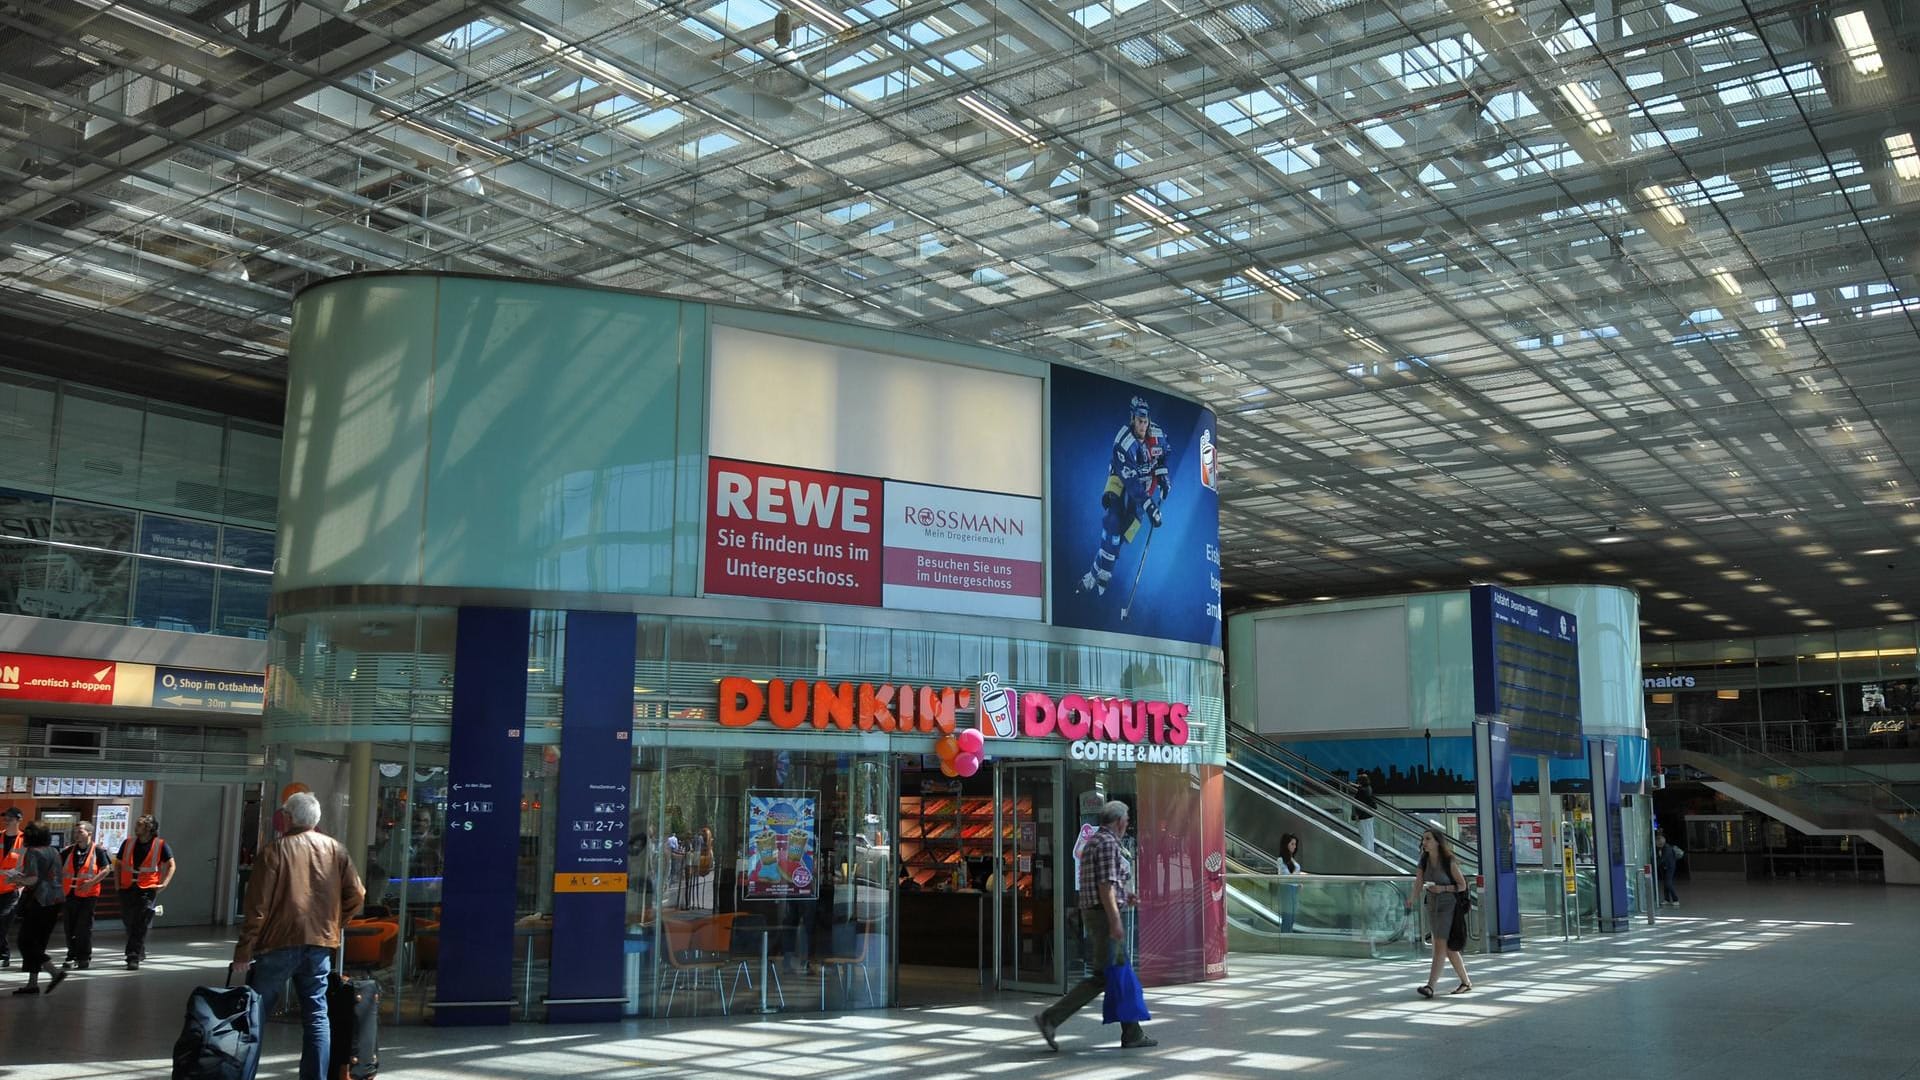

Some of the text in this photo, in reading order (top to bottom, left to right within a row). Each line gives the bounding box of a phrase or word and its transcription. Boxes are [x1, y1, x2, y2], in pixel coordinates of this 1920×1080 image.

[716, 471, 871, 534] REWE
[904, 506, 1024, 537] ROSSMANN
[717, 528, 869, 561] Sie finden uns im
[924, 528, 1005, 545] Mein Drogeriemarkt
[726, 557, 860, 588] Untergeschoss.
[917, 555, 1012, 575] Besuchen Sie uns
[917, 570, 1012, 590] im Untergeschoss
[0, 665, 19, 683] N
[71, 680, 111, 692] shoppen
[180, 678, 202, 691] Shop
[204, 680, 216, 690] im
[207, 698, 226, 709] 30m
[719, 676, 970, 734] DUNKIN'
[1020, 691, 1190, 746] DONUTS
[1071, 740, 1189, 764] COFFEE & MORE
[464, 801, 469, 812] 1
[464, 821, 473, 831] S
[596, 820, 615, 831] 2-7
[604, 839, 613, 849] S
